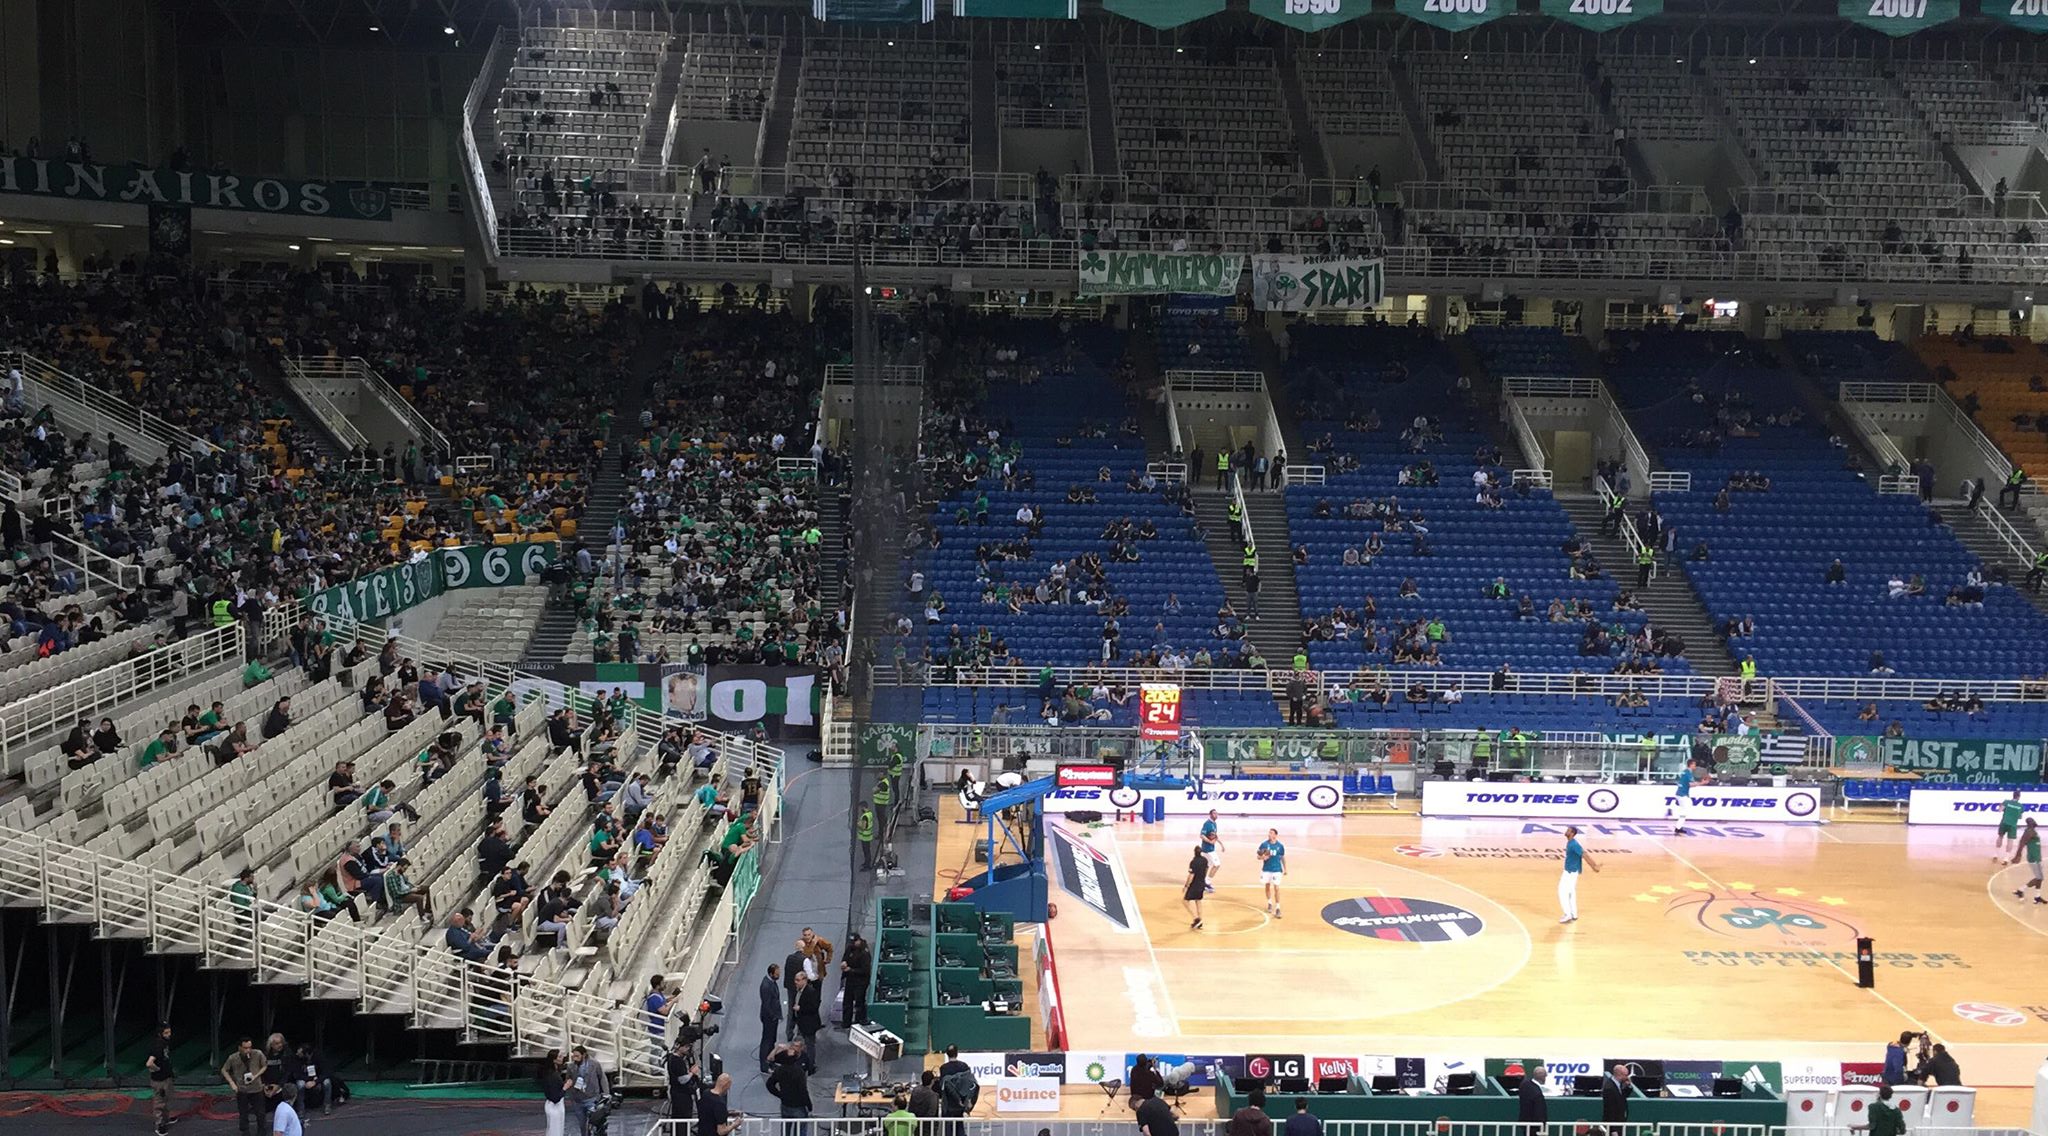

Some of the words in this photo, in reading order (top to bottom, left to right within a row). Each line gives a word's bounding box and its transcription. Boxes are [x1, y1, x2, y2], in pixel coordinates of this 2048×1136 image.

[1300, 263, 1380, 308] SPARTI
[1148, 703, 1176, 721] 24
[867, 756, 889, 764] ΘΥΡ
[1885, 739, 1959, 769] EAST
[1984, 743, 2040, 772] END
[1045, 789, 1101, 799] TIRES
[1238, 791, 1300, 801] TIRES
[1466, 793, 1520, 803] TOYO
[1520, 793, 1580, 804] TIRES
[1665, 796, 1721, 808] TYO
[1721, 797, 1778, 808] TIRES
[1521, 823, 1765, 838] ATHENS
[1455, 851, 1566, 861] EuroLeag
[1682, 950, 1918, 962] PANATHINAIOS
[1691, 959, 1973, 969] SUPERFODS
[1039, 1062, 1064, 1074] wallet
[1274, 1060, 1299, 1077] LG
[1319, 1059, 1354, 1077] Kelly's
[1546, 1063, 1590, 1074] TOYO
[1784, 1075, 1838, 1085] SUPERFOODS
[1000, 1087, 1057, 1103] Quince
